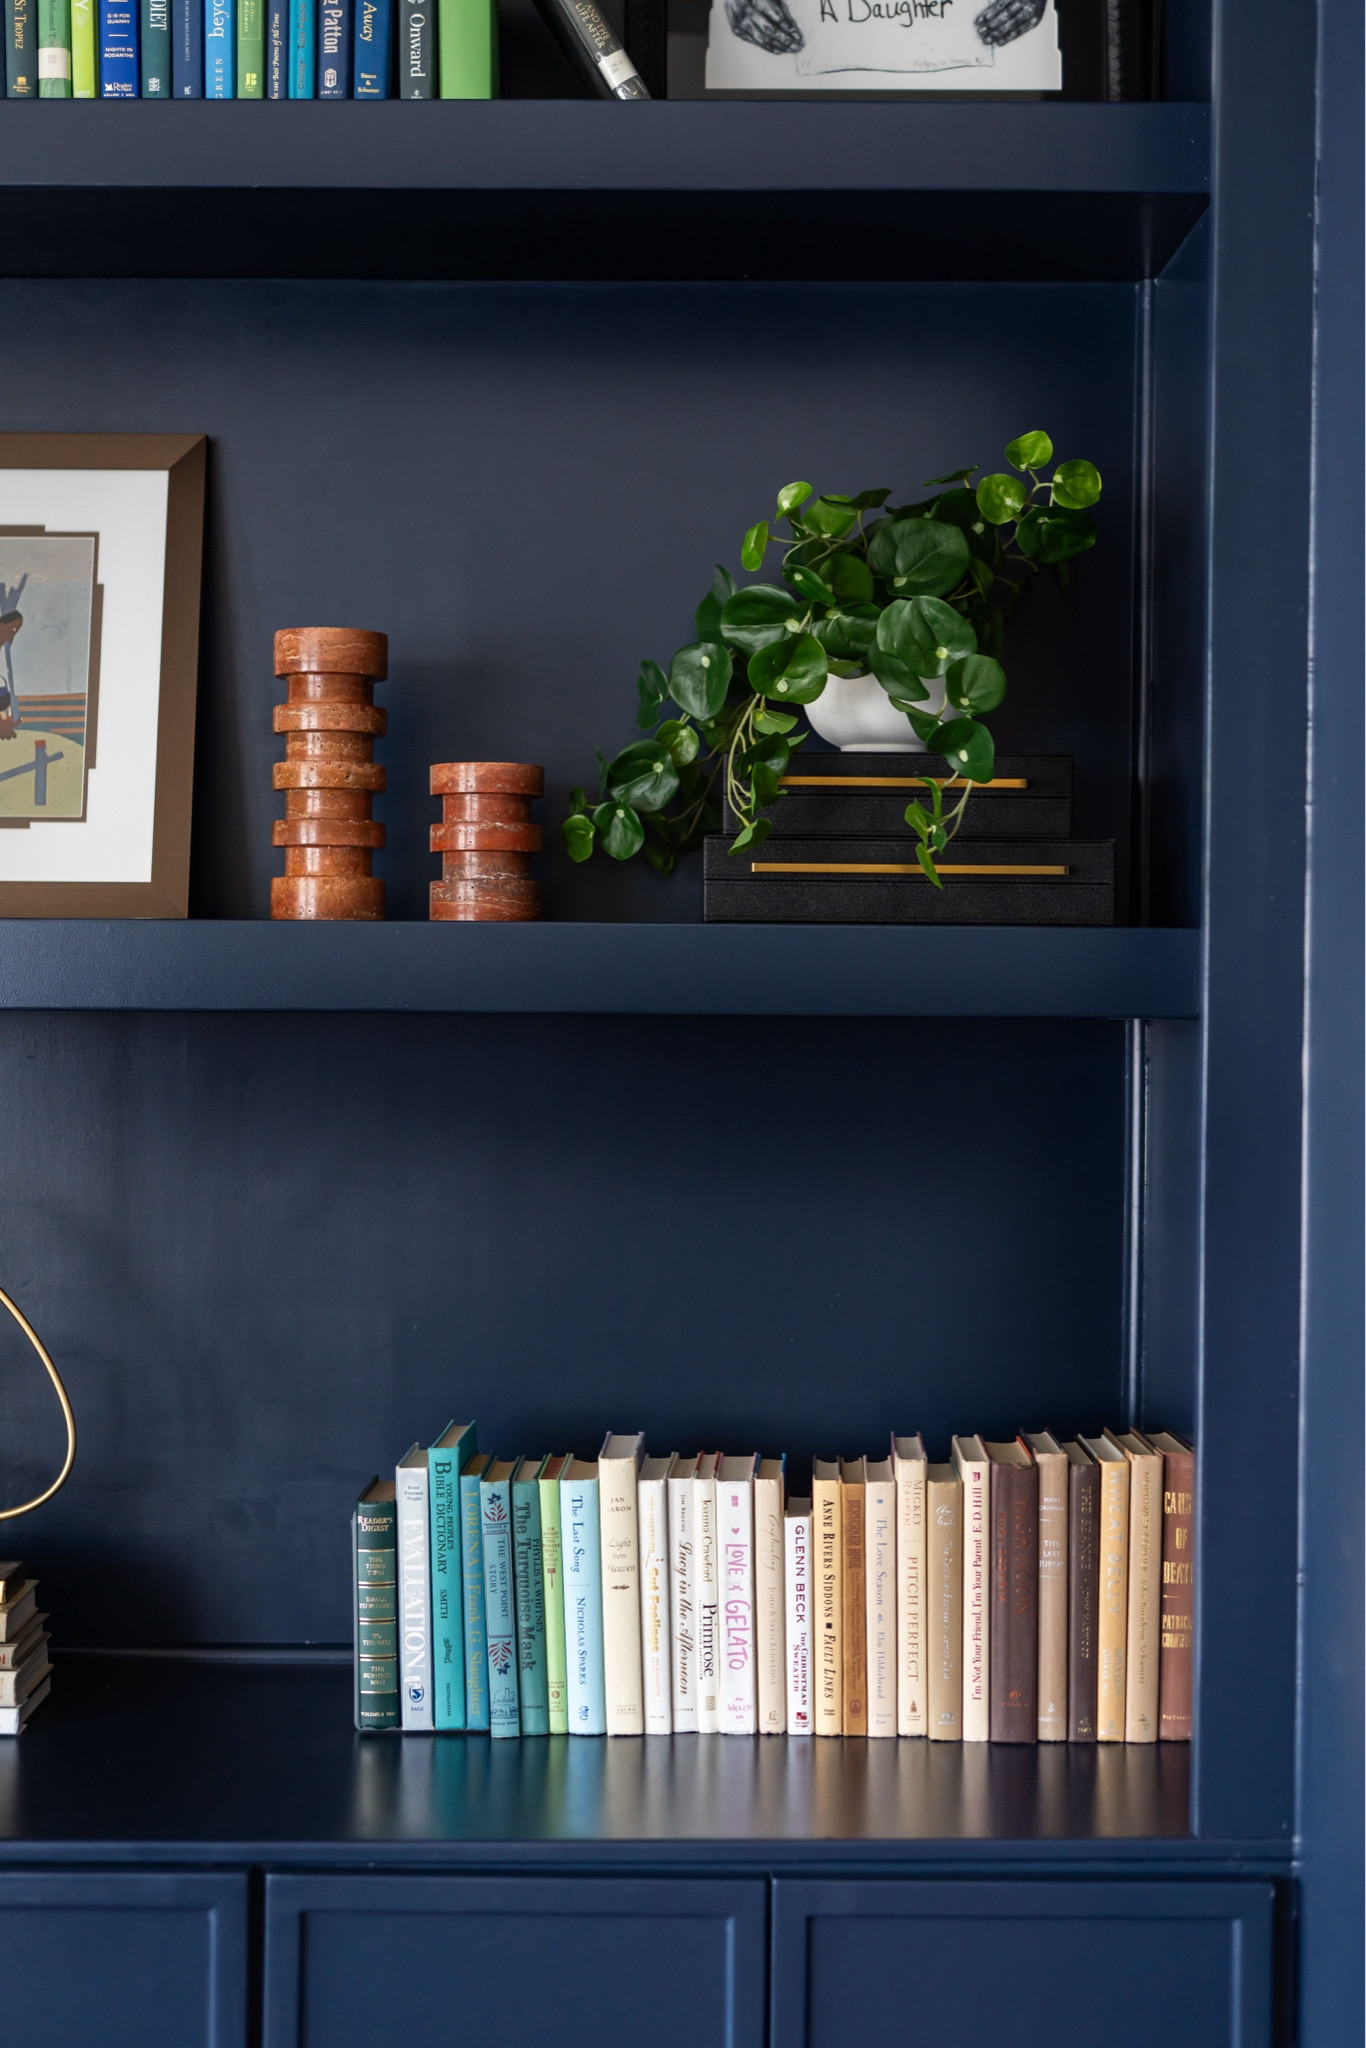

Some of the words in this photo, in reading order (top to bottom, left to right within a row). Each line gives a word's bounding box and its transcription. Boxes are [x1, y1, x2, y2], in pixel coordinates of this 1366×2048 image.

[150, 0, 167, 30] DIET
[272, 13, 280, 29] Time
[360, 2, 378, 42] Away
[576, 2, 590, 22] LIFE
[586, 23, 606, 48] AFTER
[584, 4, 600, 23] AND
[597, 22, 610, 41] THE
[819, 0, 839, 22] A
[845, 0, 954, 28] Daughter
[15, 15, 27, 49] TROPEZ
[271, 30, 280, 39] All
[324, 10, 343, 54] Patton
[410, 14, 426, 78] Onward
[272, 47, 280, 66] Poems
[435, 1461, 452, 1498] BIBLE
[571, 1495, 584, 1517] The
[823, 1499, 834, 1527] ANNE
[902, 1481, 912, 1526] RAPKIN
[913, 1480, 923, 1527] MICKEY
[973, 1487, 982, 1508] Hill
[1081, 1486, 1092, 1513] THE
[1108, 1471, 1123, 1542] WHEAT
[1141, 1472, 1150, 1529] NORTHWEST
[357, 1516, 392, 1524] READER'S
[361, 1524, 390, 1532] DIGEST
[465, 1492, 480, 1566] LORENA
[515, 1503, 531, 1534] The
[572, 1522, 584, 1543] Last
[700, 1499, 711, 1533] Joanna
[847, 1499, 861, 1546] BERSERKER
[876, 1517, 887, 1537] The
[1015, 1501, 1029, 1549] HIGH
[436, 1504, 447, 1575] DICTIONARY
[608, 1537, 631, 1547] Light
[760, 1514, 780, 1571] Captivating
[795, 1525, 805, 1577] GLENN
[823, 1533, 835, 1569] RIVERS
[876, 1542, 887, 1567] Love
[973, 1539, 982, 1567] Parent
[1141, 1533, 1149, 1571] CORNER
[1176, 1528, 1187, 1549] OF
[499, 1561, 507, 1587] WEST
[533, 1538, 541, 1576] PHYLLIS
[571, 1547, 585, 1573] Song
[674, 1540, 692, 1576] Lucy
[702, 1536, 712, 1582] Crawford
[725, 1544, 748, 1576] LOVE
[848, 1548, 861, 1569] BASE
[403, 1519, 426, 1668] EVALUATION
[489, 1565, 497, 1594] STORY
[516, 1538, 534, 1622] Turquoise
[534, 1579, 541, 1587] A.
[649, 1567, 659, 1591] Gut
[679, 1580, 691, 1594] in
[823, 1574, 835, 1618] SIDDONS
[876, 1571, 887, 1605] Season
[907, 1557, 919, 1605] PITCH
[973, 1570, 982, 1590] Your
[1015, 1557, 1030, 1614] NOON
[1107, 1553, 1122, 1614] BELLY
[440, 1589, 448, 1619] SMITH
[468, 1585, 481, 1624] Frank
[500, 1590, 508, 1619] POINT
[535, 1589, 543, 1633] WHITNEY
[679, 1598, 693, 1619] the
[795, 1583, 805, 1623] BECK
[972, 1593, 982, 1607] I'm
[469, 1630, 481, 1646] G.
[576, 1598, 586, 1647] NICHOLAS
[649, 1595, 660, 1652] Feelings
[725, 1600, 751, 1670] GELATO
[972, 1610, 982, 1641] Friend,
[520, 1626, 536, 1671] Mask
[702, 1603, 717, 1677] Primrose
[824, 1634, 836, 1664] FAULT
[877, 1632, 885, 1648] Elin
[908, 1612, 919, 1682] PERFECT
[972, 1643, 982, 1664] Your
[578, 1649, 588, 1685] SPARKS
[675, 1623, 694, 1695] Afternoon
[877, 1651, 886, 1699] Hilderbrand
[972, 1667, 982, 1683] Not
[1101, 1649, 1110, 1680] DAVIS,
[1114, 1649, 1124, 1695] WILLIAM
[467, 1651, 483, 1716] Slaughter
[824, 1668, 836, 1699] LINES
[972, 1686, 982, 1701] I'm
[1101, 1683, 1109, 1696] MD
